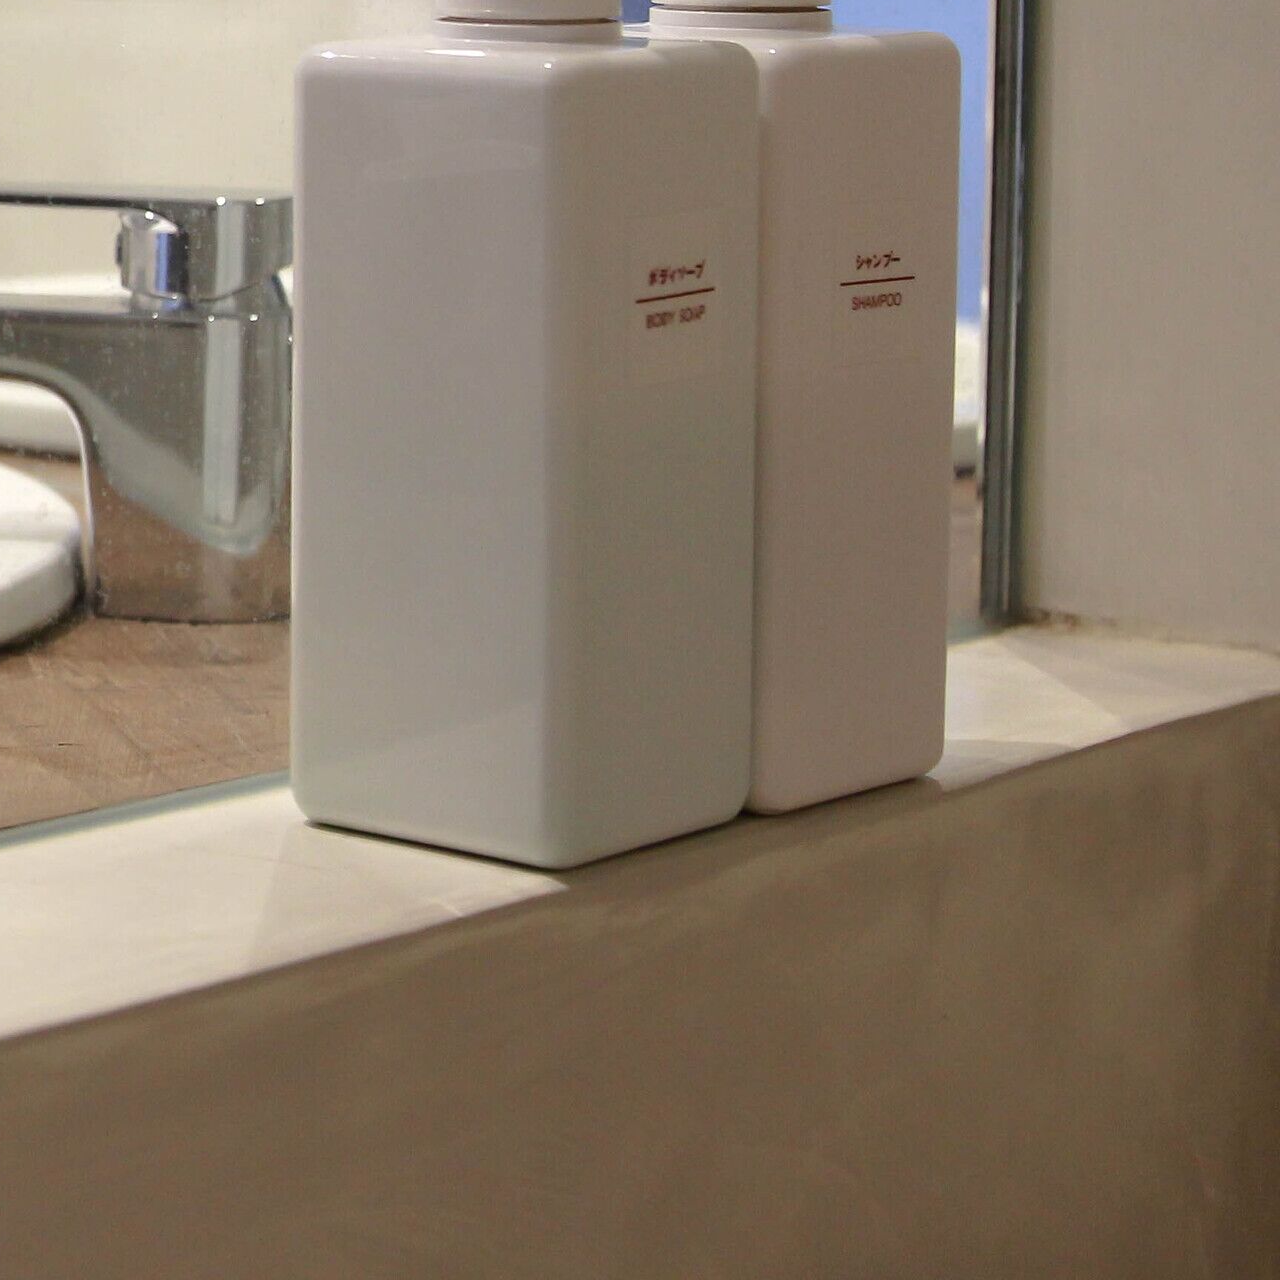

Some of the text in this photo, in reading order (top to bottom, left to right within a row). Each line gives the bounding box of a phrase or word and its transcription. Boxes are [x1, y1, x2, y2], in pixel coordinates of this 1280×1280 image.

[856, 250, 901, 270] シャンプー
[851, 292, 902, 311] SHAMPOO
